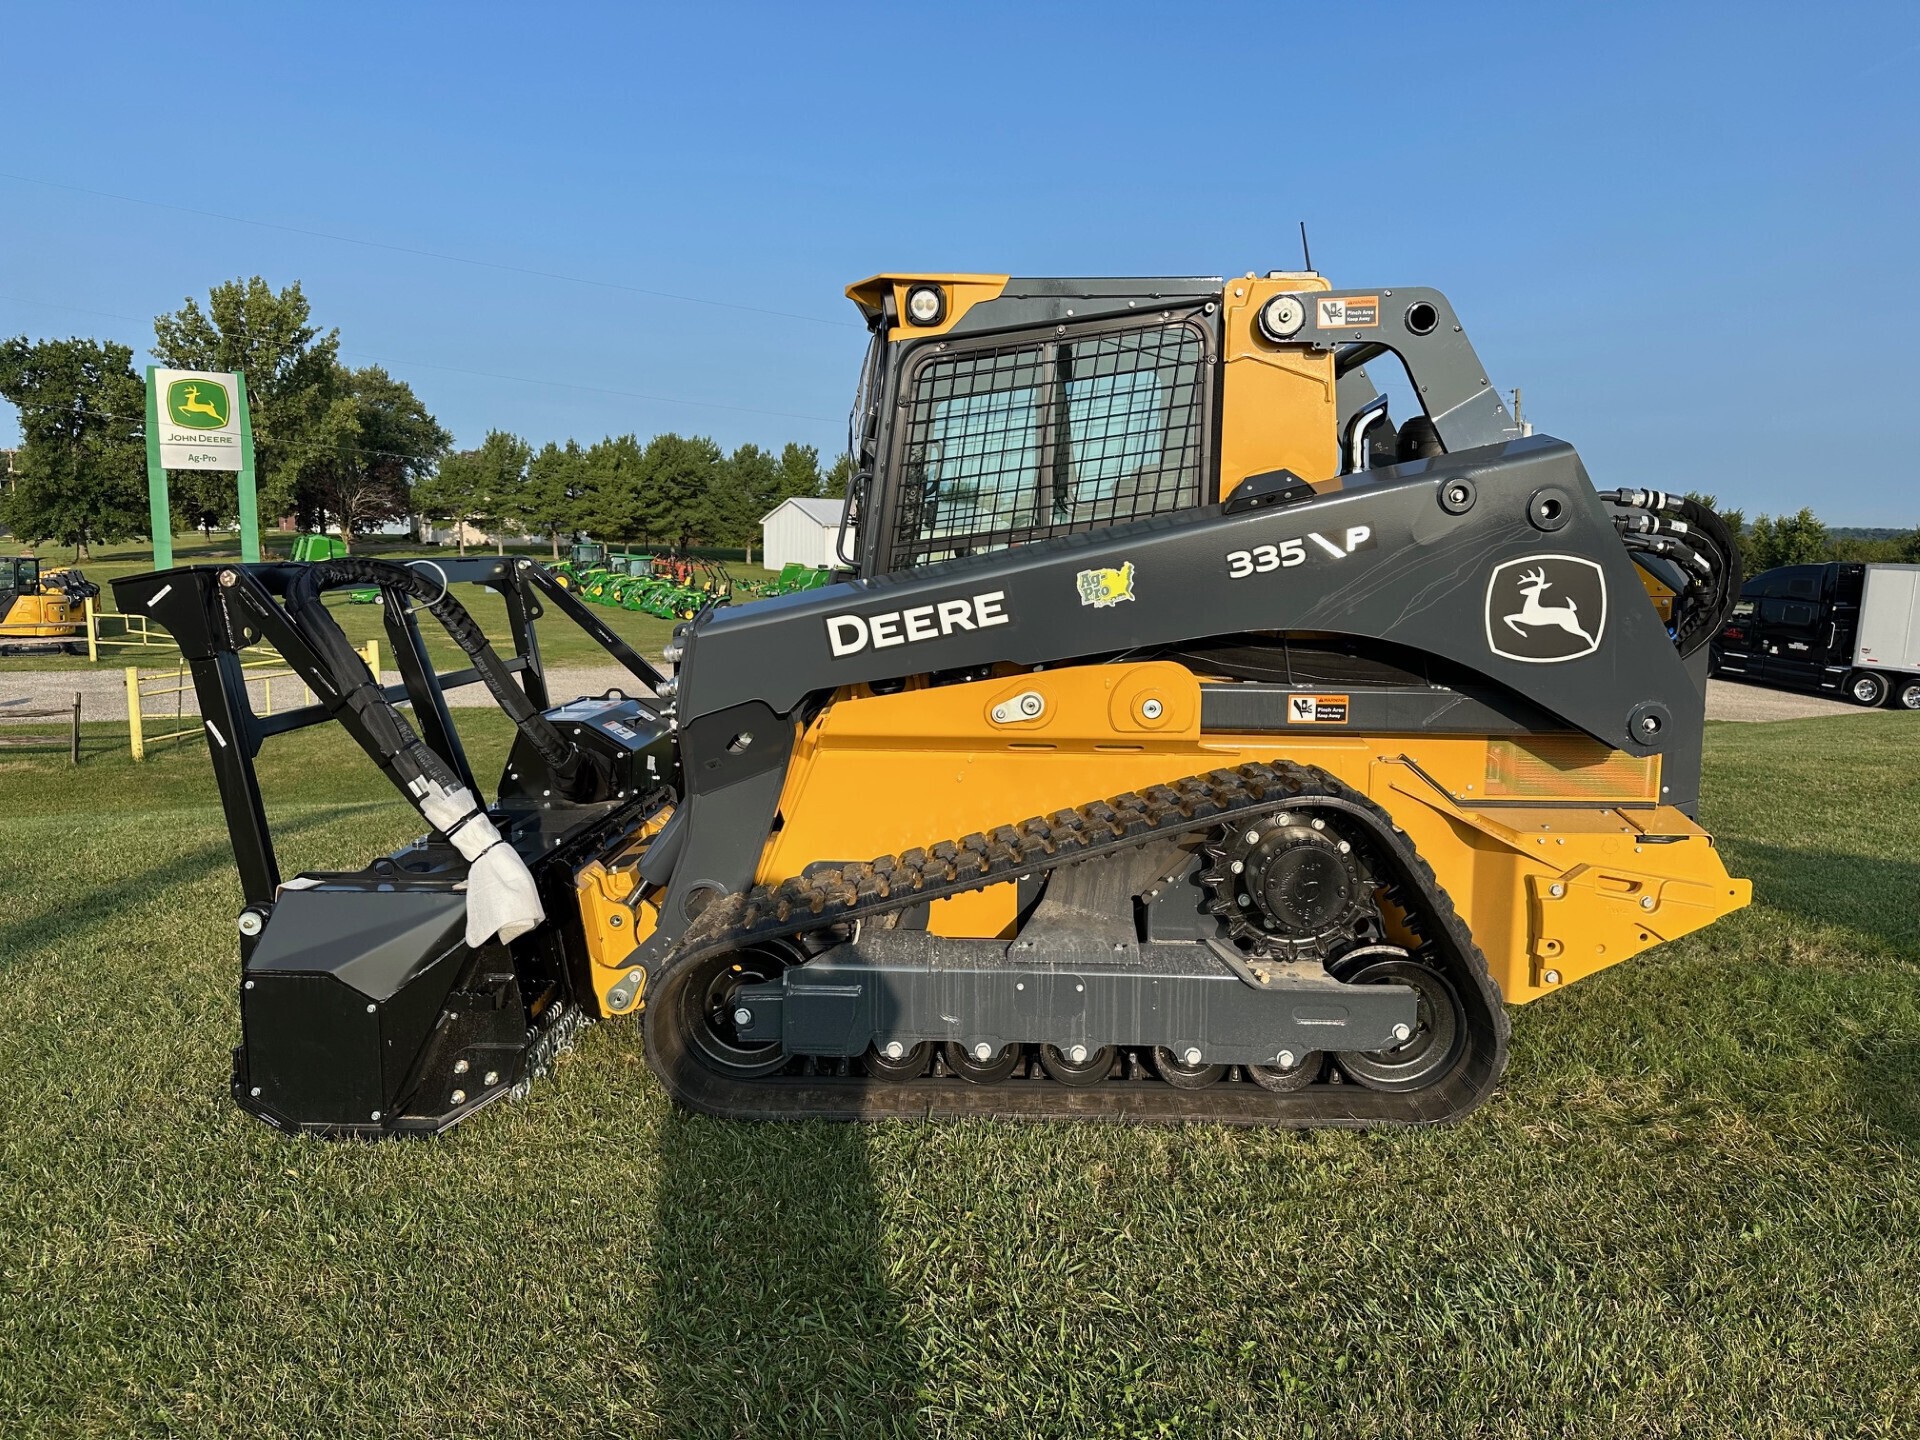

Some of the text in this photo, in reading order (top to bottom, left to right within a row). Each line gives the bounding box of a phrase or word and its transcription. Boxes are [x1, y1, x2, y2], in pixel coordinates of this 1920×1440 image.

[168, 433, 232, 443] JOHN DEERE
[188, 453, 217, 463] Ag-Pro
[1226, 538, 1307, 579] 335
[1081, 573, 1107, 589] Ag-
[1082, 586, 1110, 602] Pro
[826, 590, 1009, 657] DEERE
